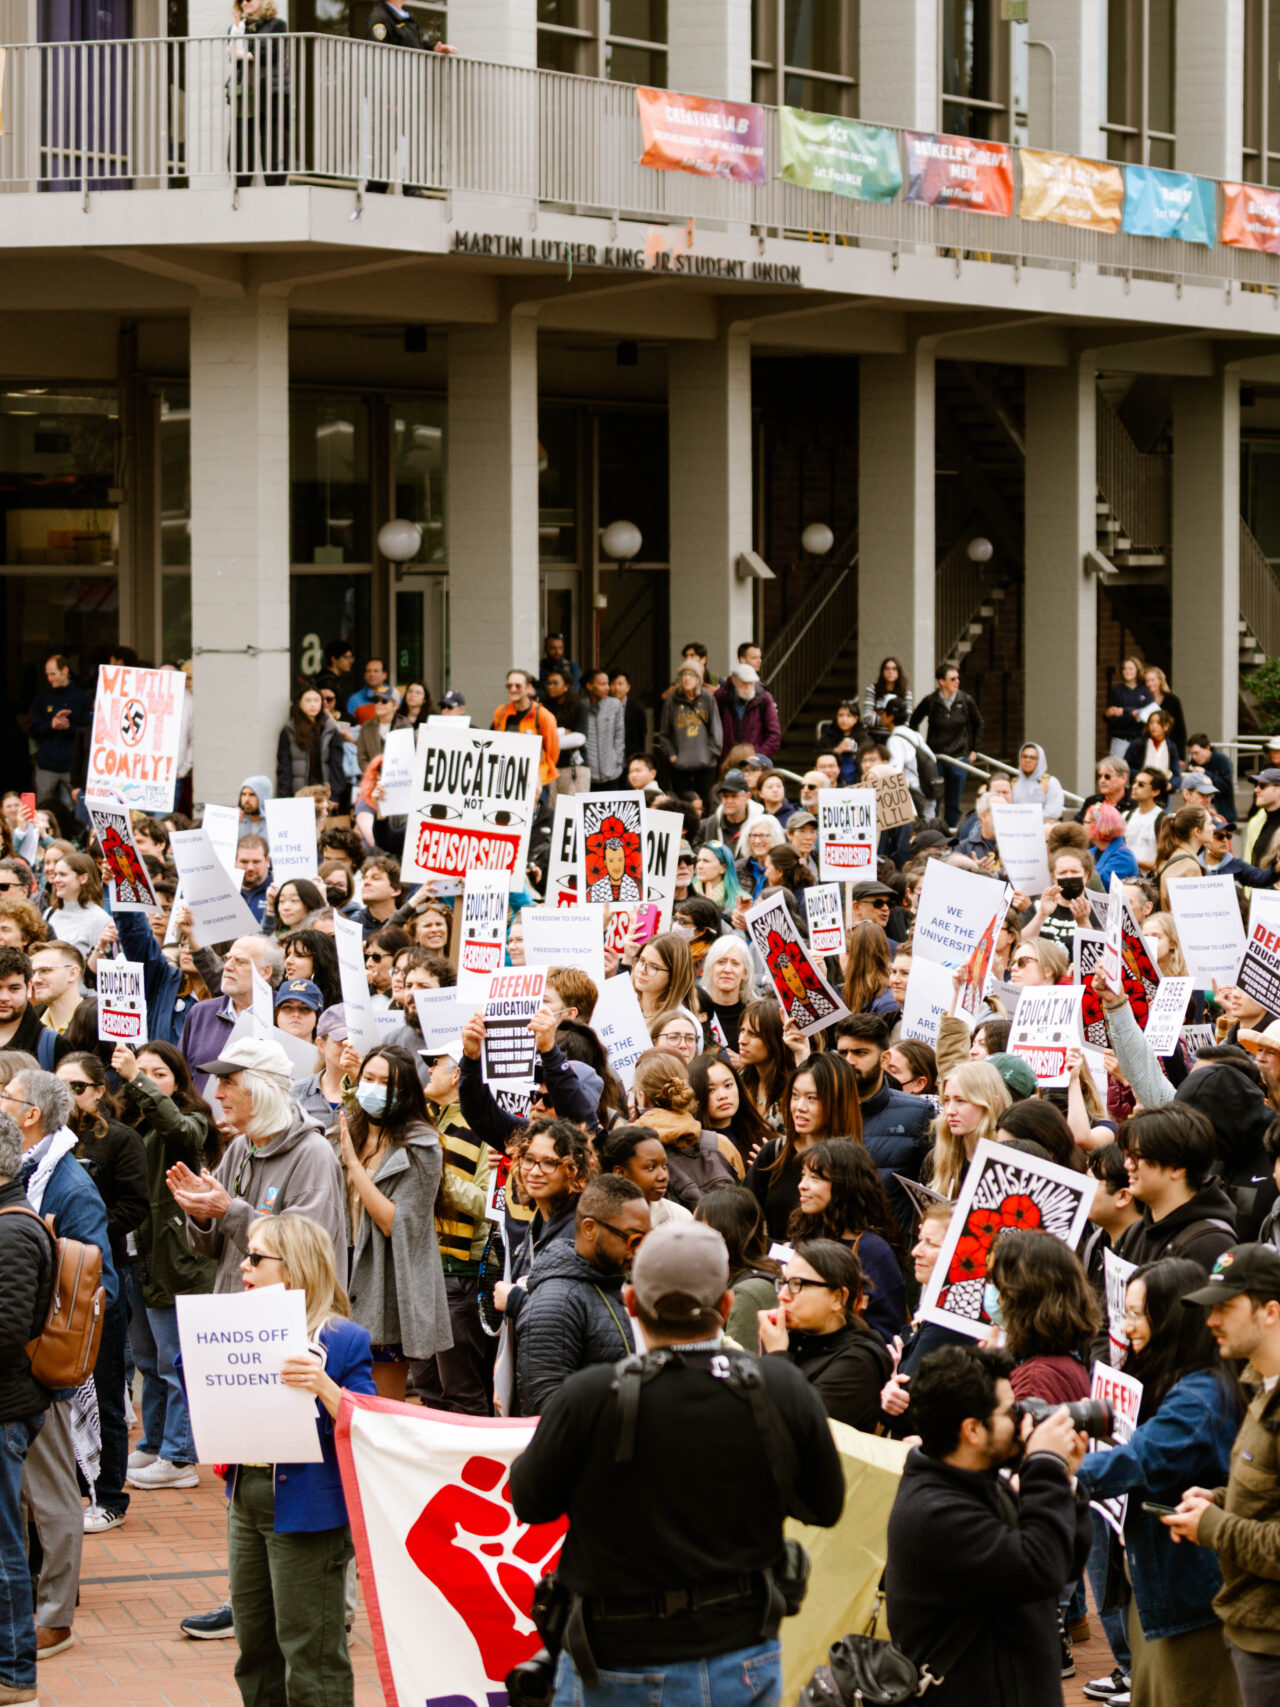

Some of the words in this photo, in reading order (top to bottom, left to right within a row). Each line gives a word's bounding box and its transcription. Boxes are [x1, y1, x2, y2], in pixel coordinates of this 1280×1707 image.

[664, 105, 721, 130] CREATIVE
[454, 229, 523, 257] MARTIN
[531, 237, 597, 266] LUTHER
[604, 247, 645, 269] KING
[675, 253, 747, 281] STUDENT
[753, 261, 801, 283] UNION
[302, 633, 322, 676] a
[102, 666, 131, 697] WE
[135, 670, 174, 700] WILL
[93, 746, 173, 781] COMPLY!
[423, 748, 530, 801] EDUCATION
[464, 799, 484, 810] NOT
[823, 805, 871, 828] EDUCATION
[285, 844, 302, 852] THE
[417, 829, 515, 871] CENSORSHIP
[826, 846, 870, 865] CENSORSHIP
[466, 892, 505, 922] EDUCATION
[947, 905, 964, 918] WE
[931, 917, 951, 931] ARE
[954, 925, 976, 939] THE
[1243, 965, 1269, 987] FREEDOM
[1246, 958, 1271, 980] FREEDOM
[100, 971, 140, 996] EDUCATION
[289, 981, 308, 992] Cal
[489, 974, 544, 999] DEFEND
[1164, 982, 1186, 996] FREE
[1241, 973, 1267, 996] FREEDOM
[1017, 997, 1076, 1026] EDUCATION
[1155, 999, 1185, 1012] SPEECH
[103, 1013, 140, 1036] CENSORSHIP
[601, 1024, 615, 1037] WE
[917, 1017, 936, 1031] ARE
[615, 1037, 635, 1052] THE
[197, 1331, 254, 1344] HANDS
[258, 1328, 289, 1343] OFF
[228, 1352, 262, 1365] OUR
